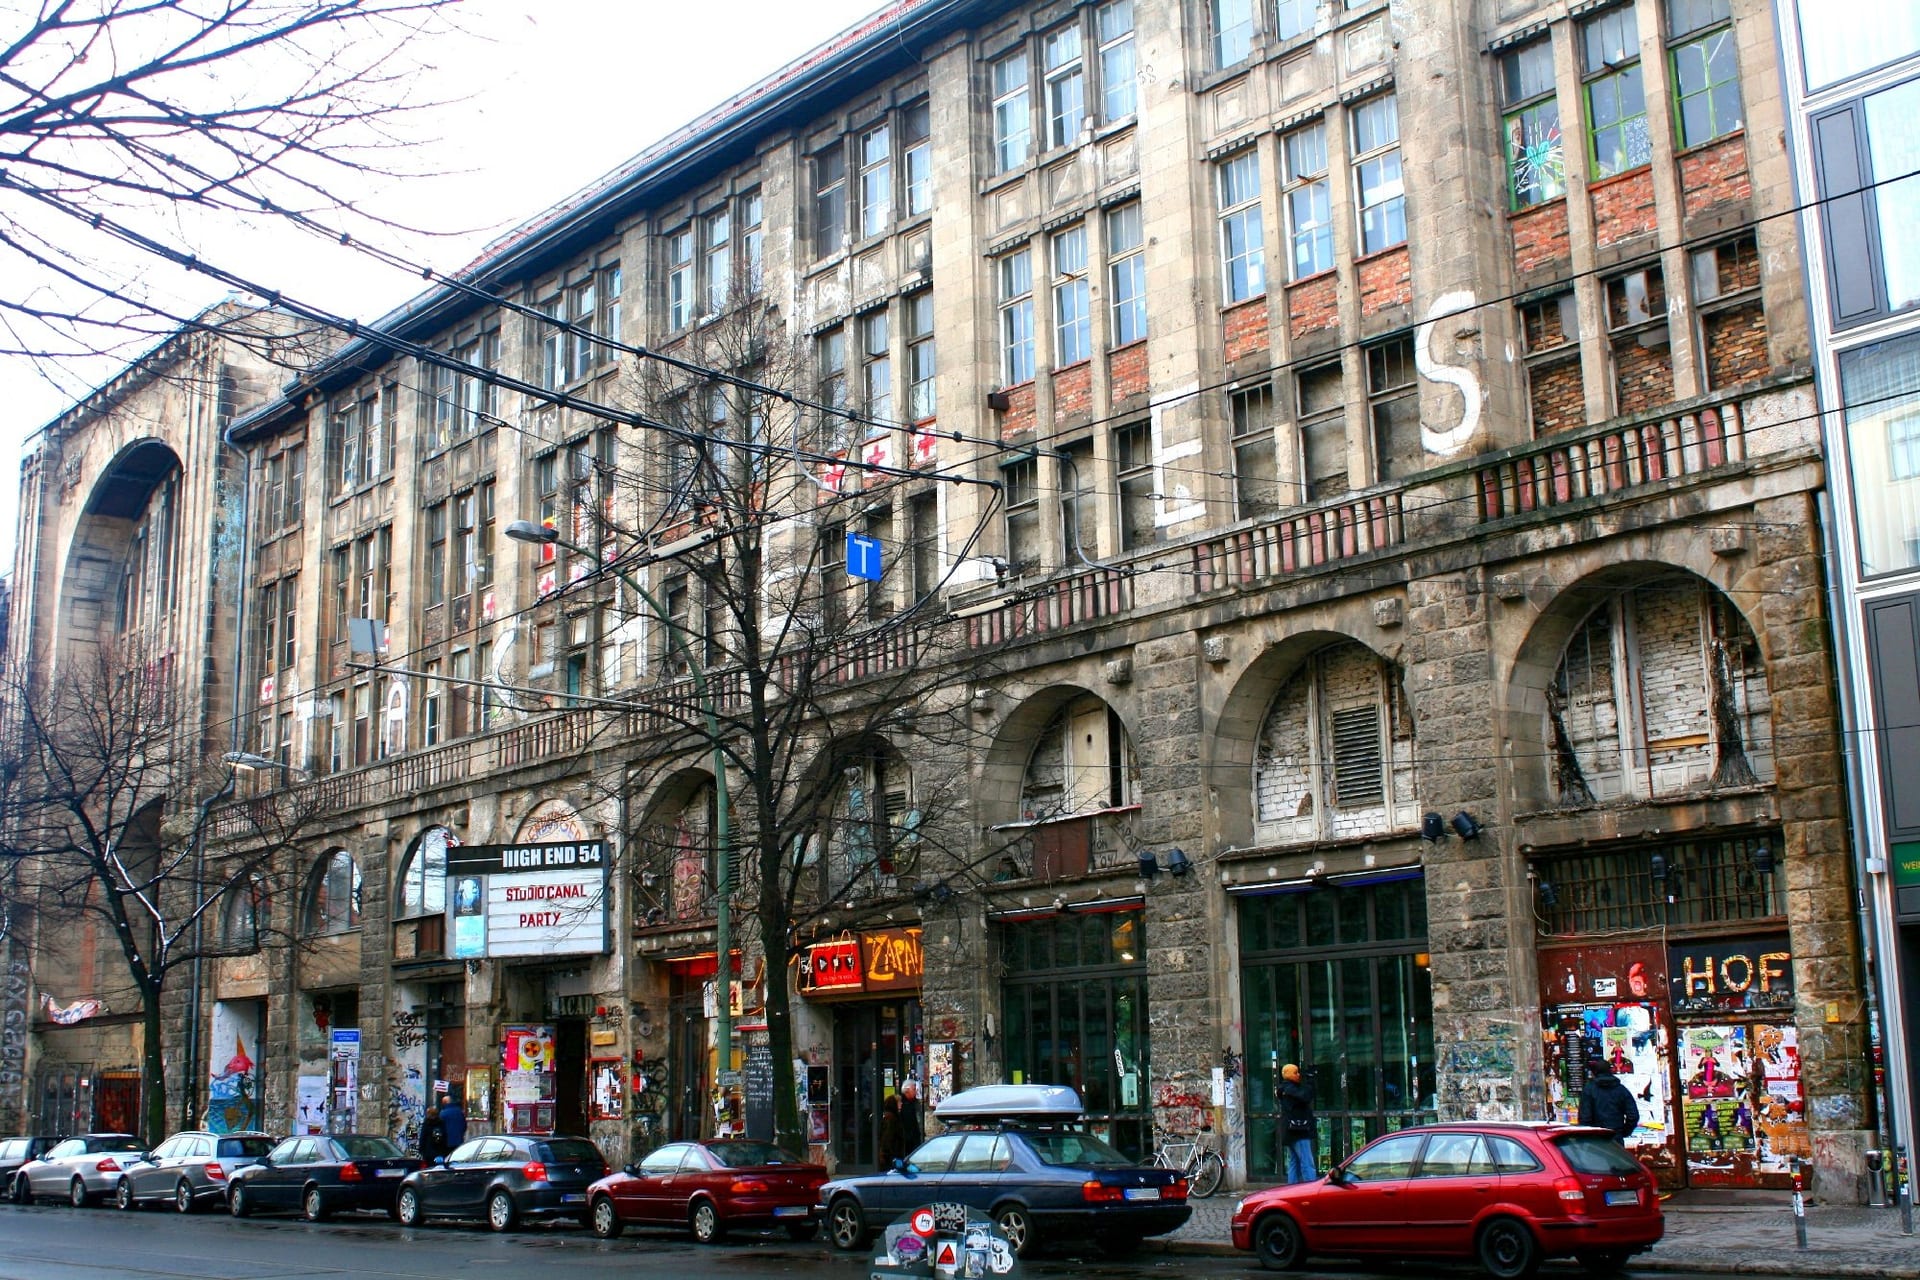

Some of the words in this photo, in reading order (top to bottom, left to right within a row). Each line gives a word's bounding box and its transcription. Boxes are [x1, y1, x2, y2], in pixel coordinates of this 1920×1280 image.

[545, 846, 576, 865] END
[579, 845, 600, 863] 54
[519, 911, 562, 928] PARTY
[1683, 952, 1792, 998] HOF
